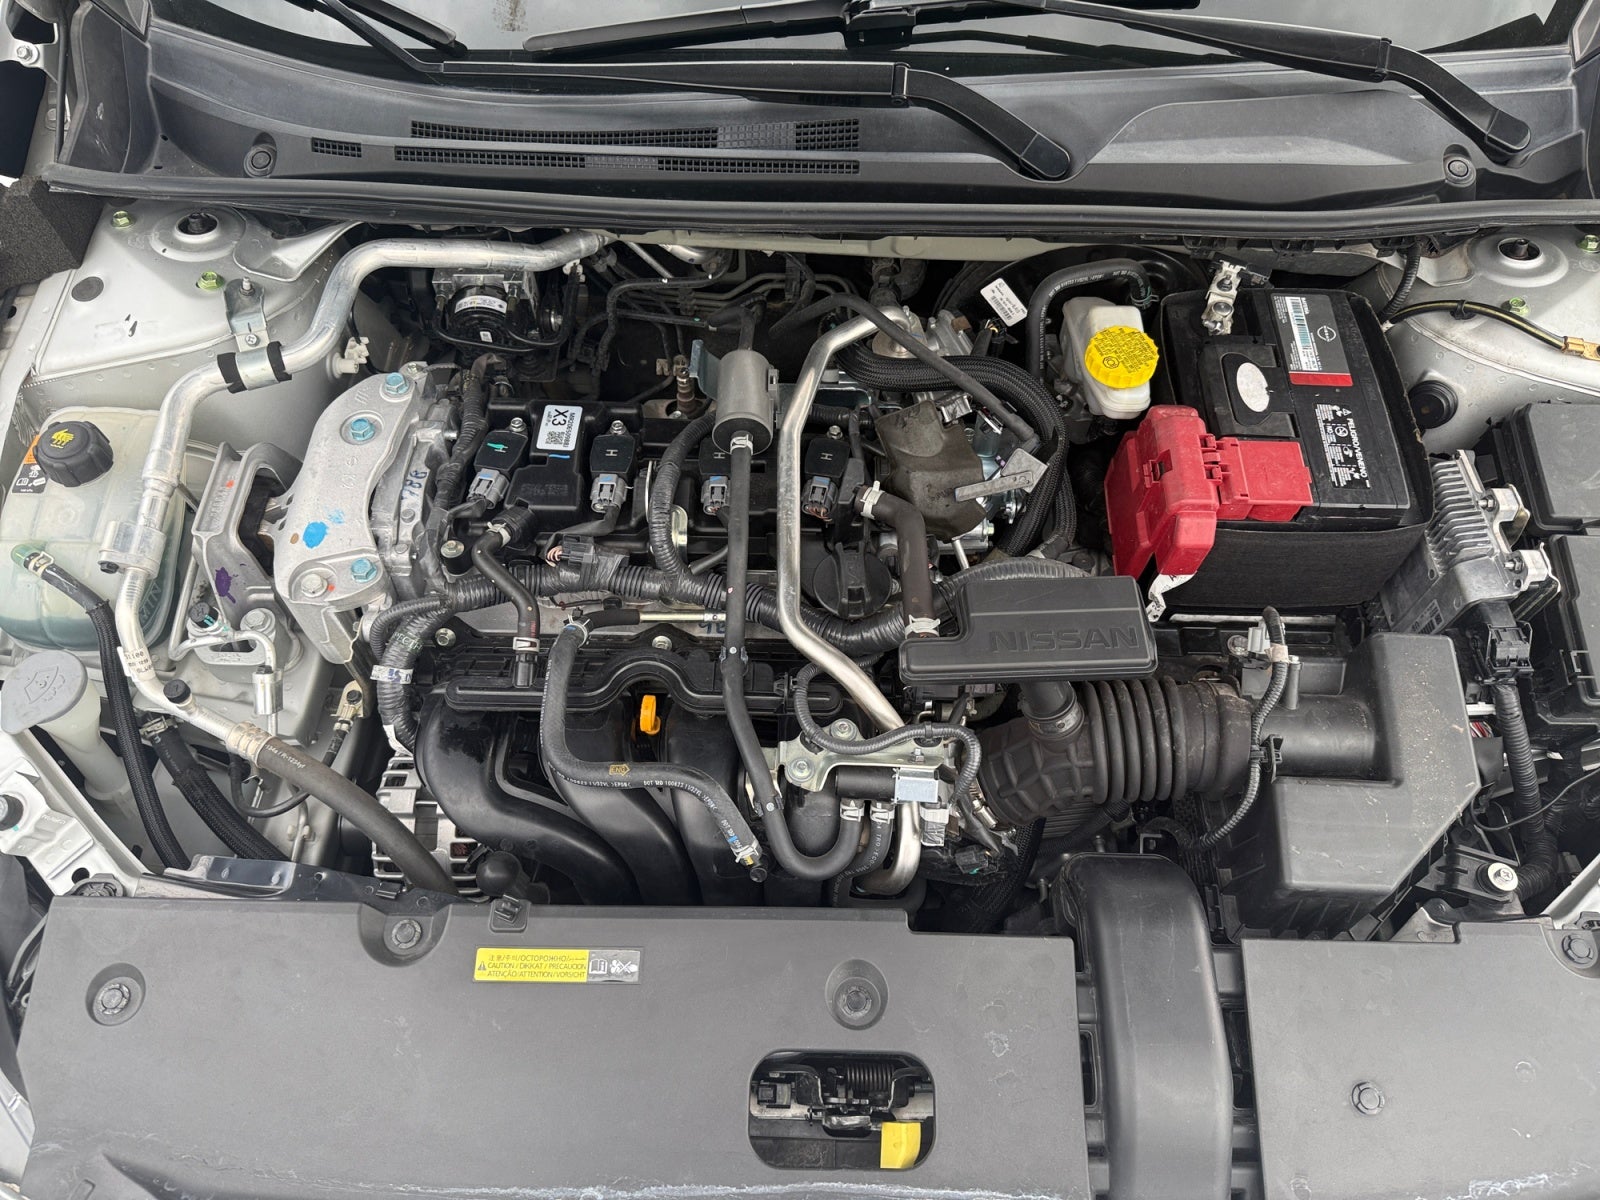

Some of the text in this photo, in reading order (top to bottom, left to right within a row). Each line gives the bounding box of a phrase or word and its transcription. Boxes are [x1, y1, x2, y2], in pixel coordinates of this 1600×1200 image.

[552, 408, 569, 426] X3
[604, 449, 618, 457] H
[820, 452, 834, 460] H
[988, 626, 1140, 654] NISSAN
